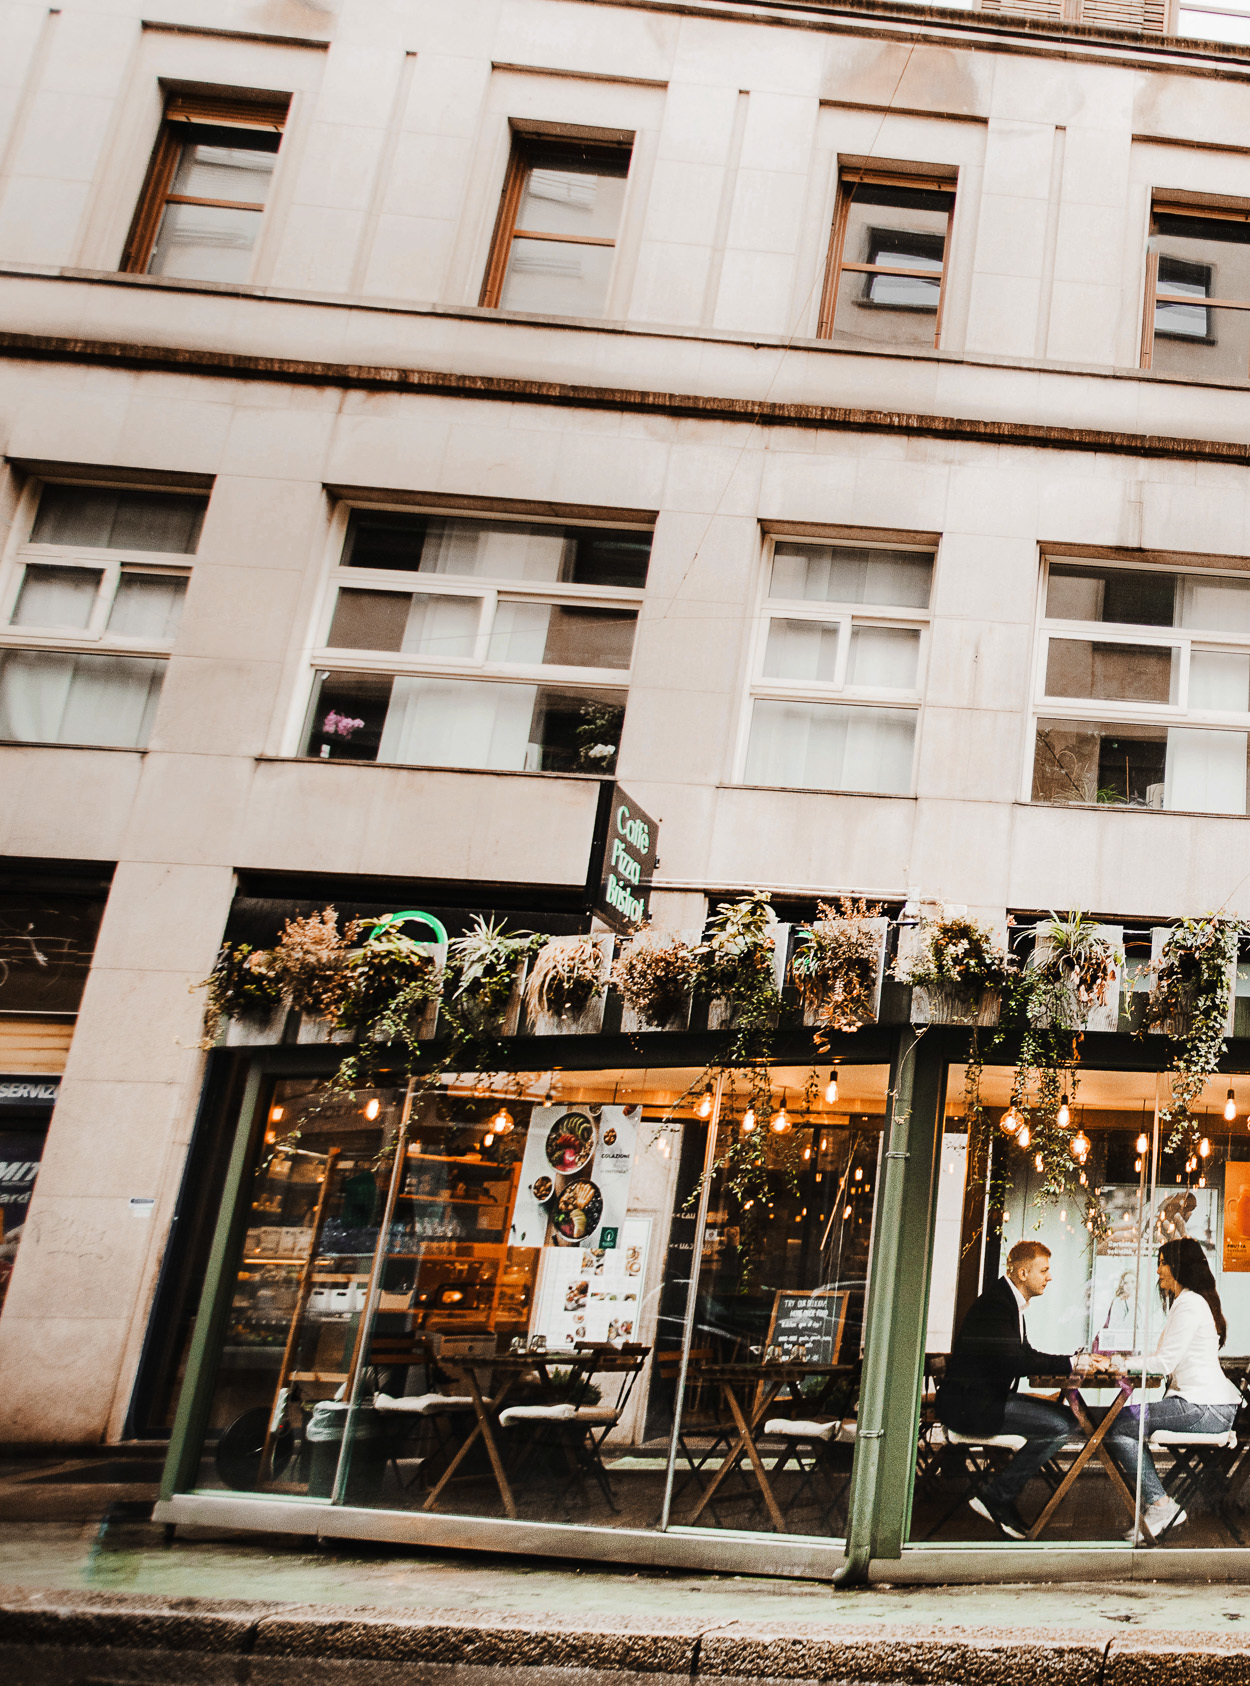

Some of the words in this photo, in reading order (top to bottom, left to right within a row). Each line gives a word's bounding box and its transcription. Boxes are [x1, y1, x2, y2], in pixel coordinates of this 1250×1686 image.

[616, 805, 650, 855] Caffè
[610, 838, 642, 886] Pizza
[784, 1299, 796, 1308] TRY
